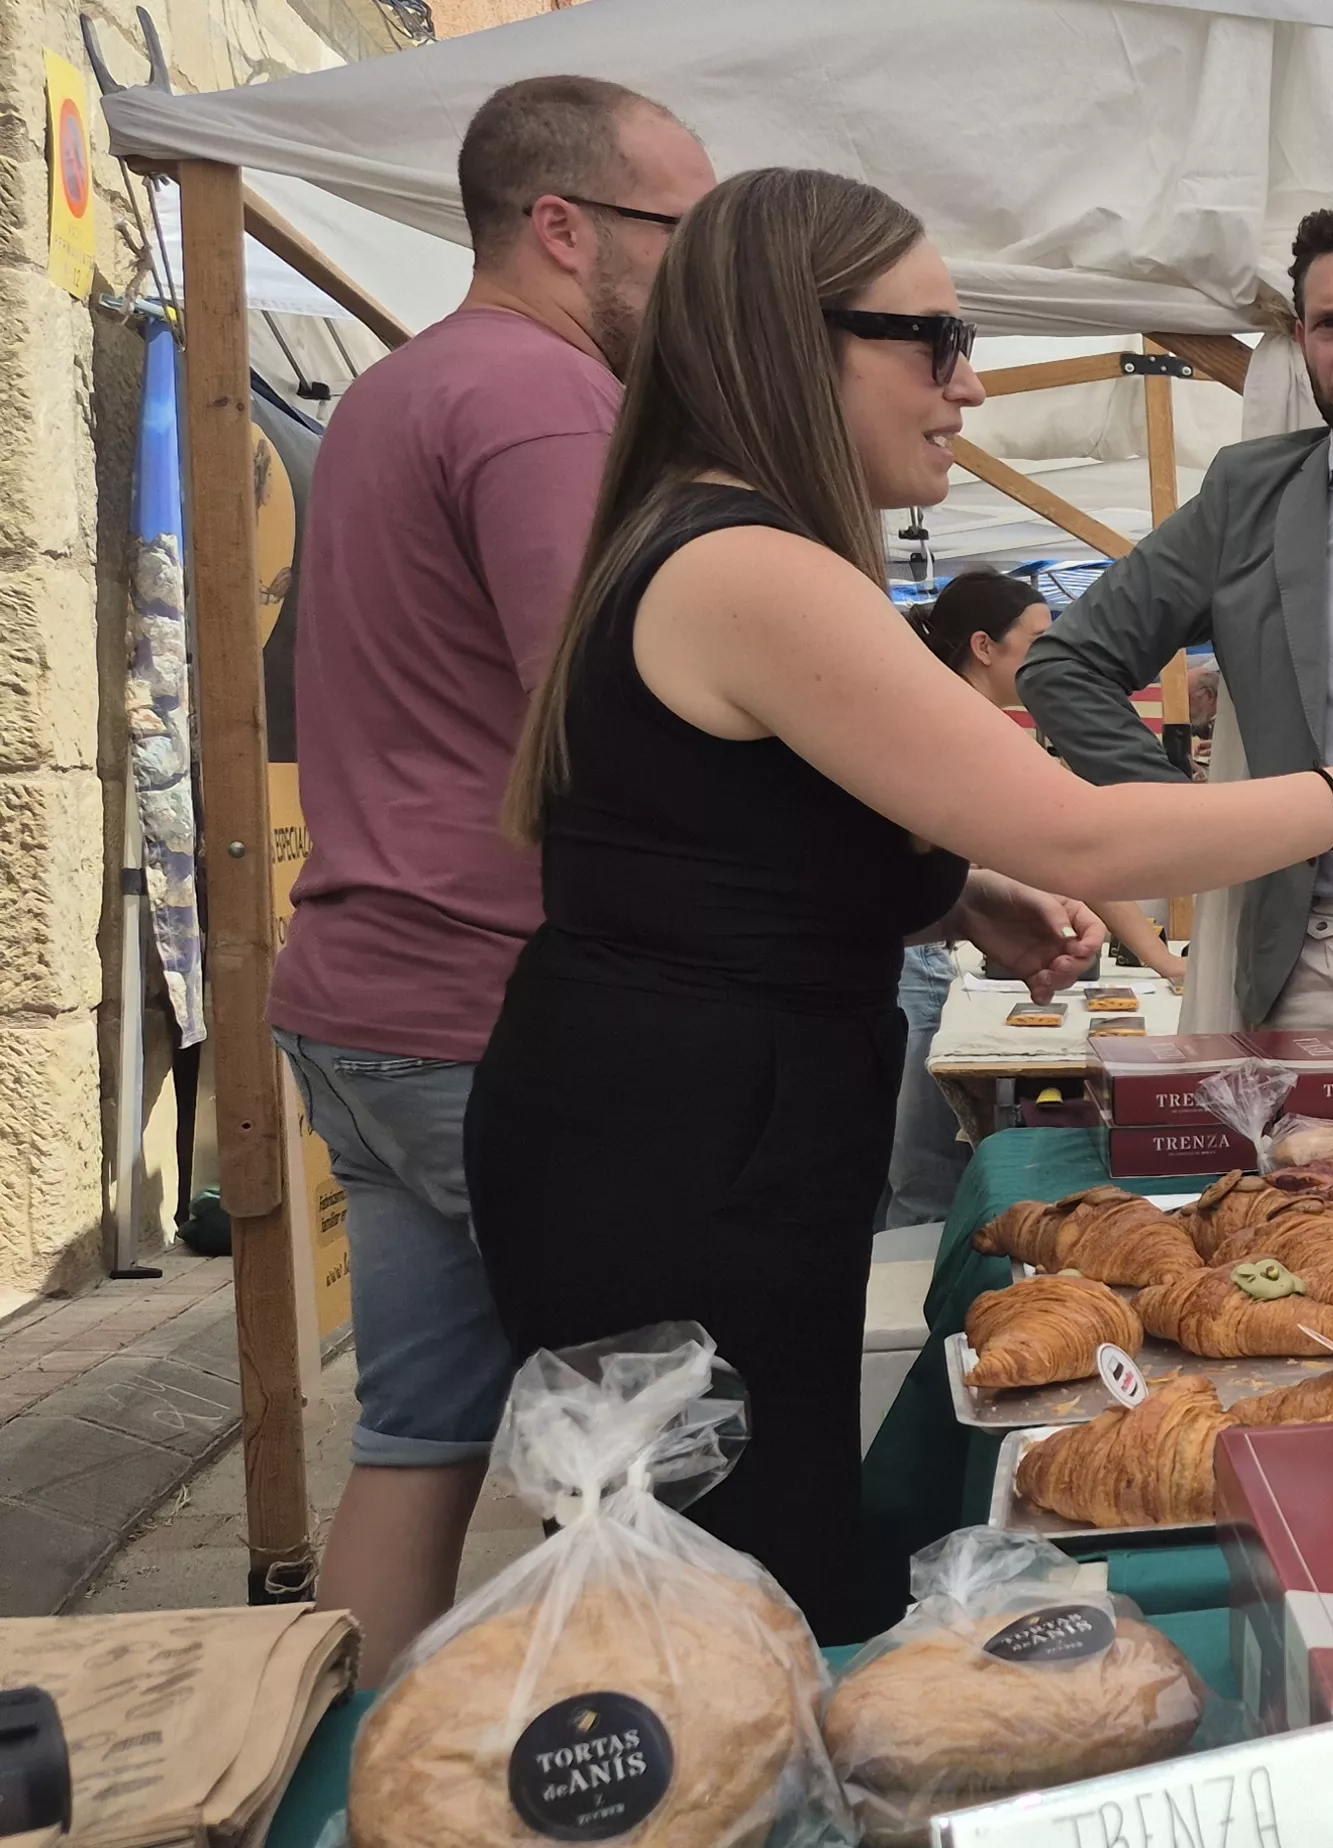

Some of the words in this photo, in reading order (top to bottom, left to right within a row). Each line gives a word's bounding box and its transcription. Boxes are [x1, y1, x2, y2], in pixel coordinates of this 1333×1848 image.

[1156, 1092, 1196, 1108] TRE
[1152, 1132, 1231, 1151] TRENZA
[535, 1728, 641, 1774] TORTAS
